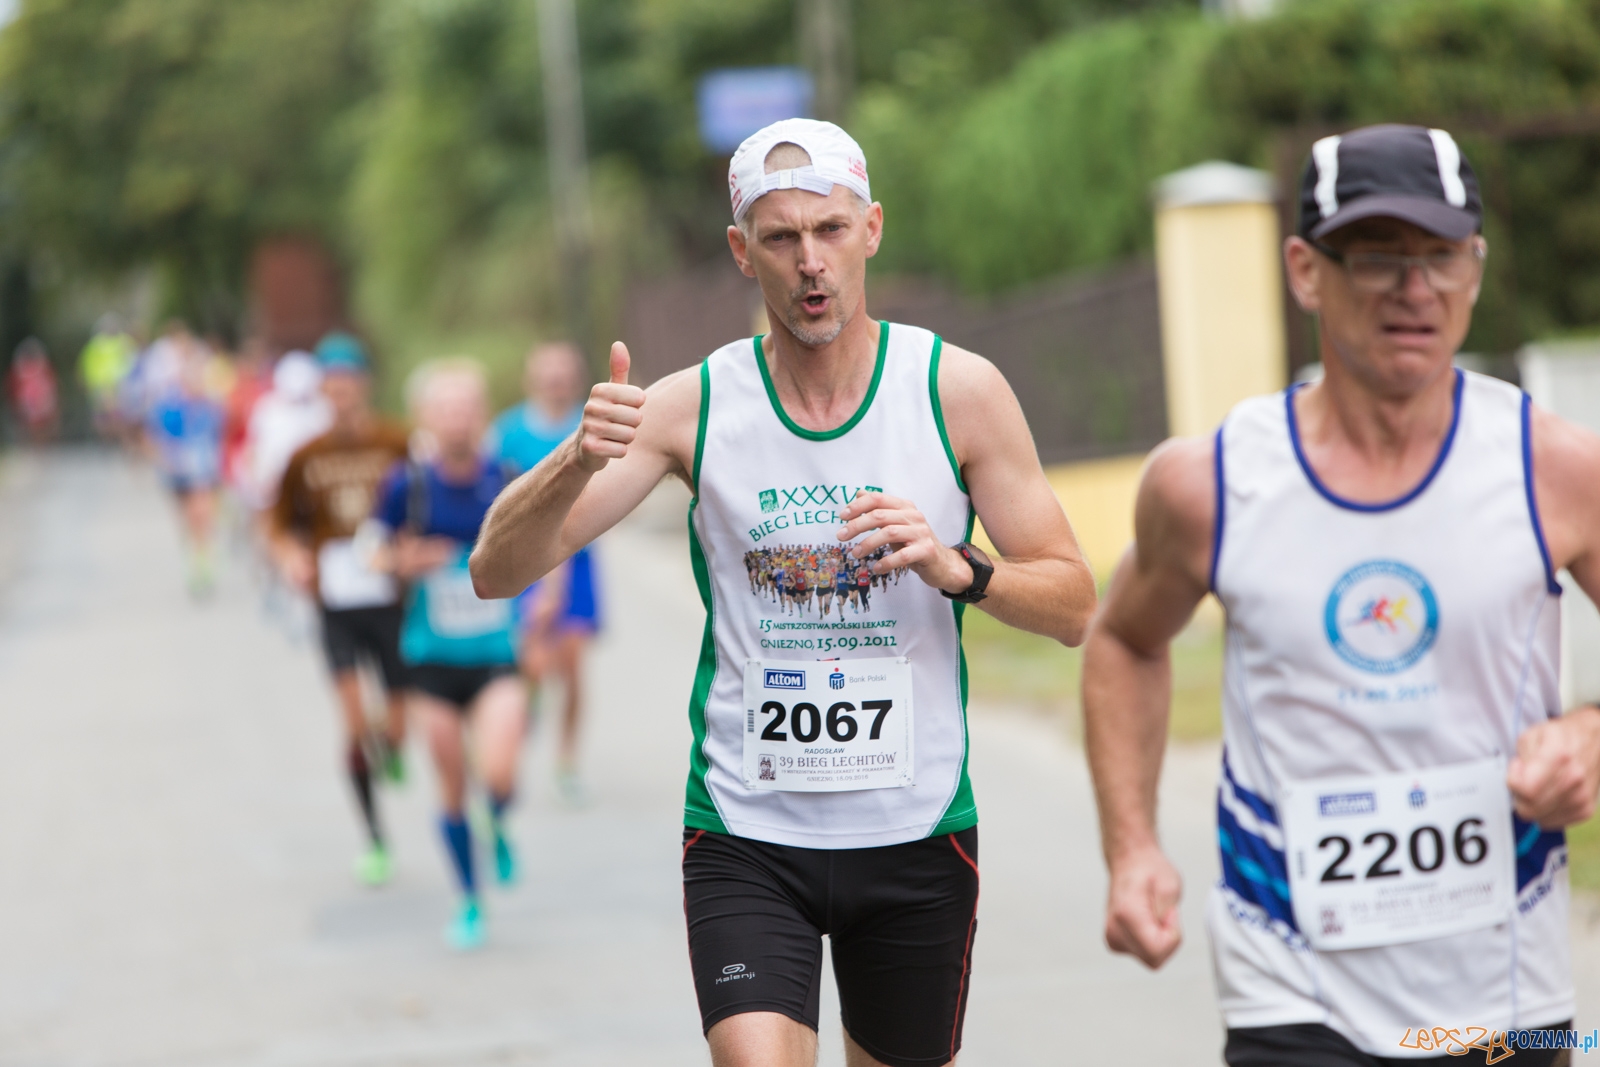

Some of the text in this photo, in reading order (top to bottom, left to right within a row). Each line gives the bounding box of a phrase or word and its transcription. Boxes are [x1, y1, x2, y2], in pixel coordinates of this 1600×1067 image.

[749, 516, 789, 542] BIEG
[759, 619, 773, 633] 15
[832, 622, 860, 630] POLSKI
[862, 620, 898, 630] LEKARZY
[760, 636, 897, 651] GNIEZNO, 15.09.2012
[849, 676, 866, 684] Bank
[867, 674, 887, 683] Polski
[760, 700, 893, 742] 2067
[779, 752, 897, 768] 39 BIEG LECHITÓW
[1317, 817, 1489, 883] 2206
